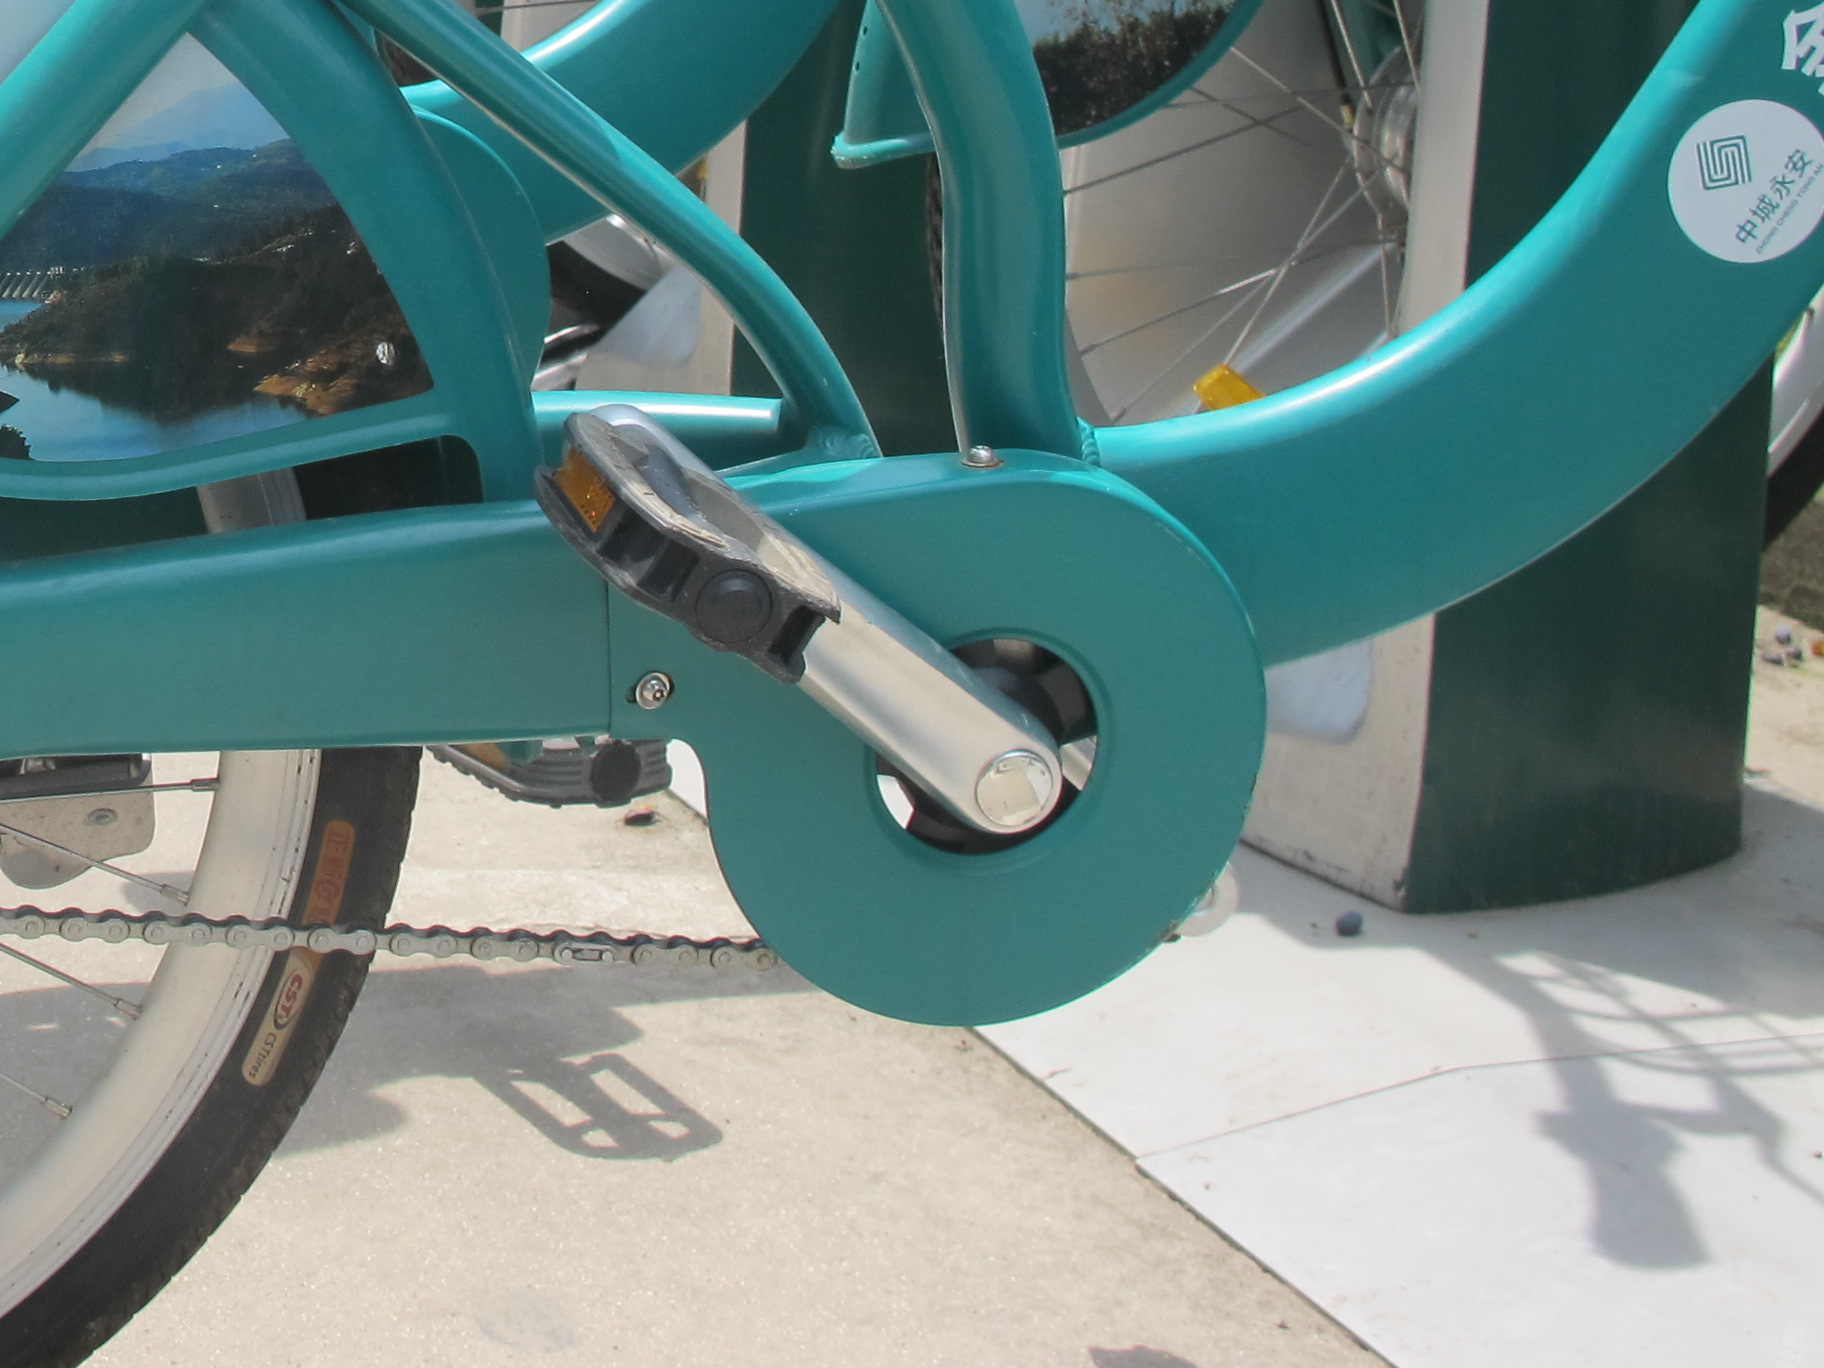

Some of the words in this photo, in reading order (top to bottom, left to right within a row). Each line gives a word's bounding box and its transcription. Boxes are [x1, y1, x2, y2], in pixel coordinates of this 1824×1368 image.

[1734, 148, 1813, 245] 中城永安
[279, 973, 304, 1021] CST
